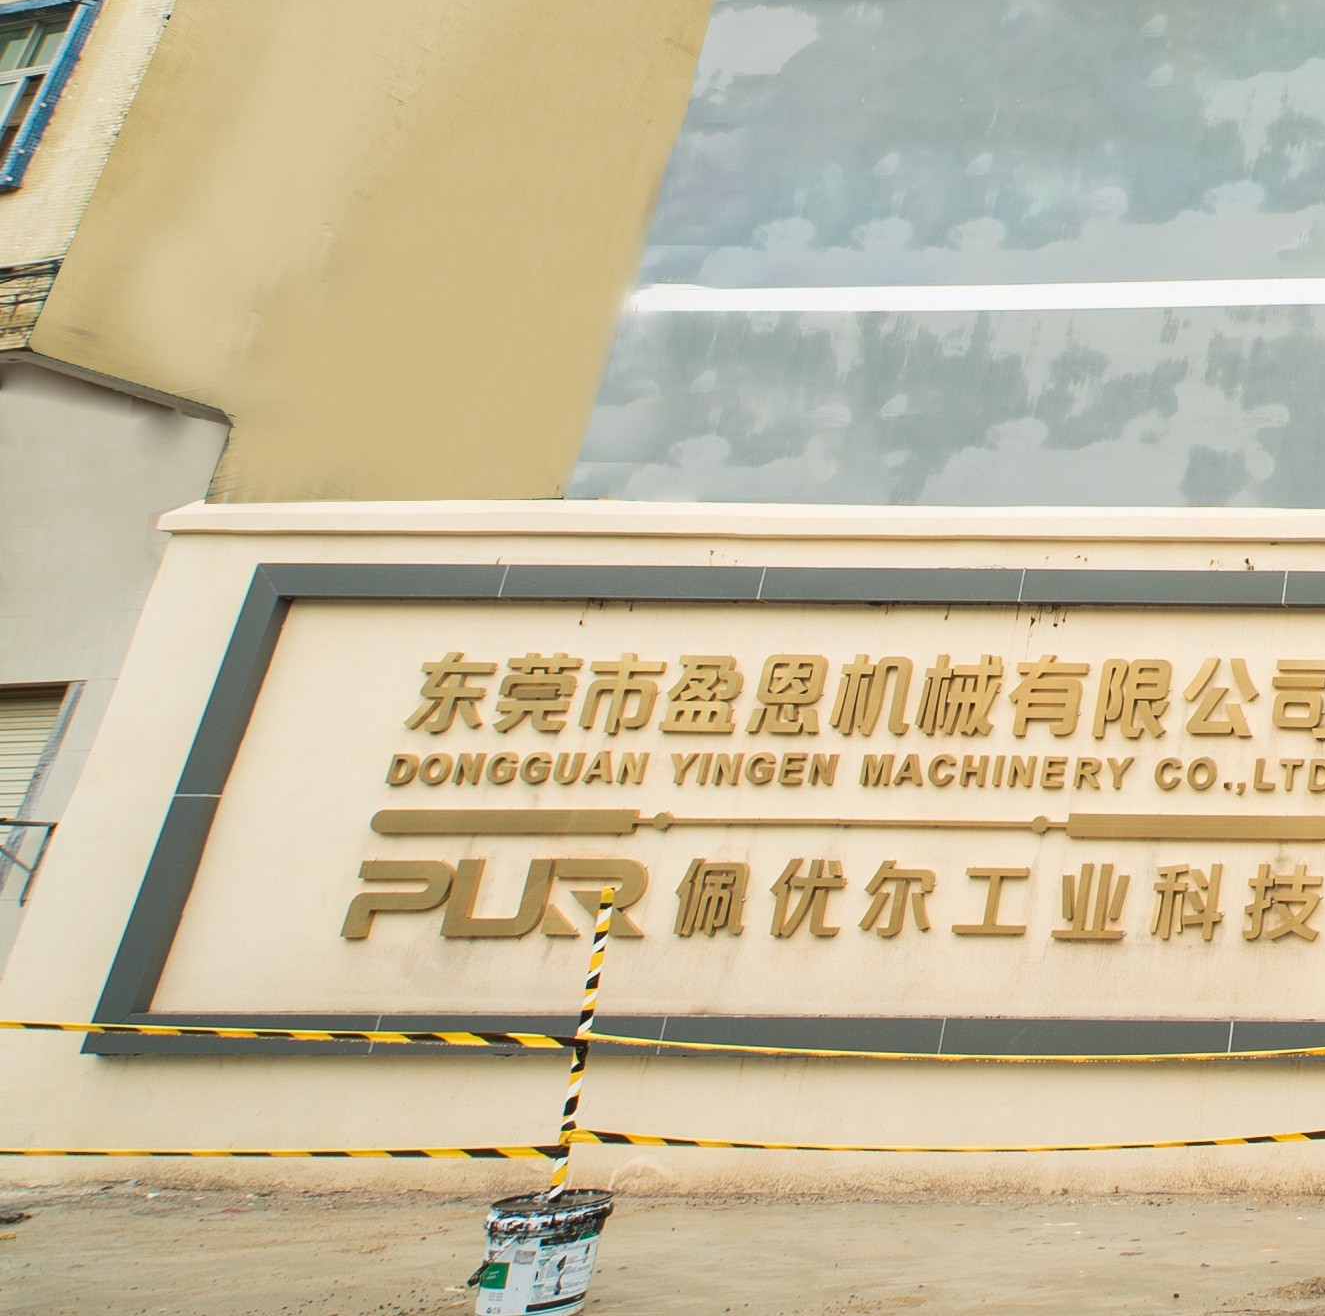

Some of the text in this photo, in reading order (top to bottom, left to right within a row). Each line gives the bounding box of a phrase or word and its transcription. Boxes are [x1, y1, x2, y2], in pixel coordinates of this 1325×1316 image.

[386, 751, 650, 787] DONGGUAN
[670, 752, 840, 788] YINGEN
[858, 753, 1135, 791] MACHINERY
[340, 856, 649, 940] PUR
[672, 856, 1325, 942] 佩优尔工业科技
